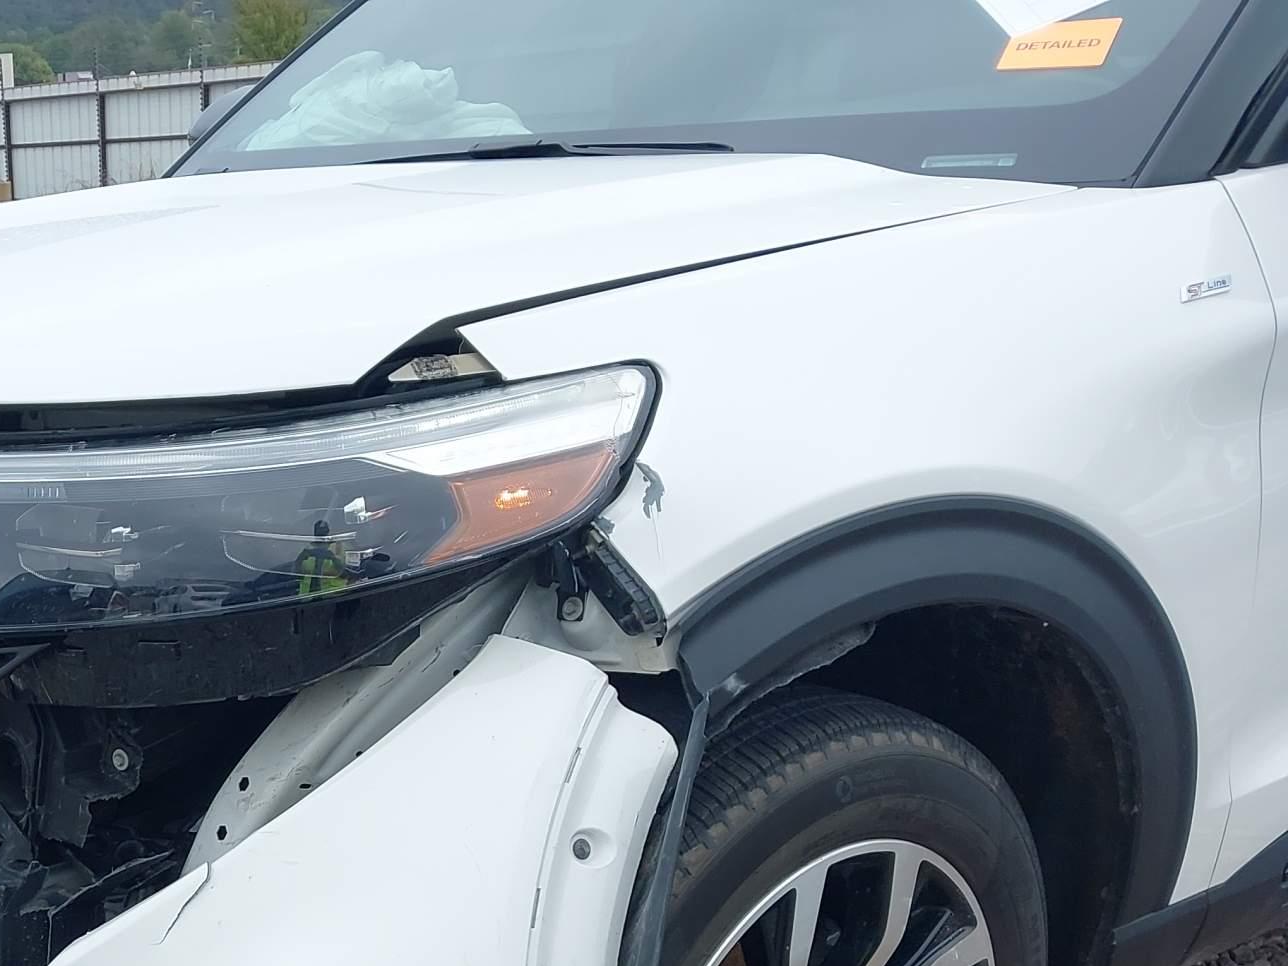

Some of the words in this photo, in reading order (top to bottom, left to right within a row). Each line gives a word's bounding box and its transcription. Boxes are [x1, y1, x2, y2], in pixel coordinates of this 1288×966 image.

[1015, 38, 1102, 52] DETAILED
[1187, 281, 1205, 299] ST
[1206, 278, 1227, 290] Line
